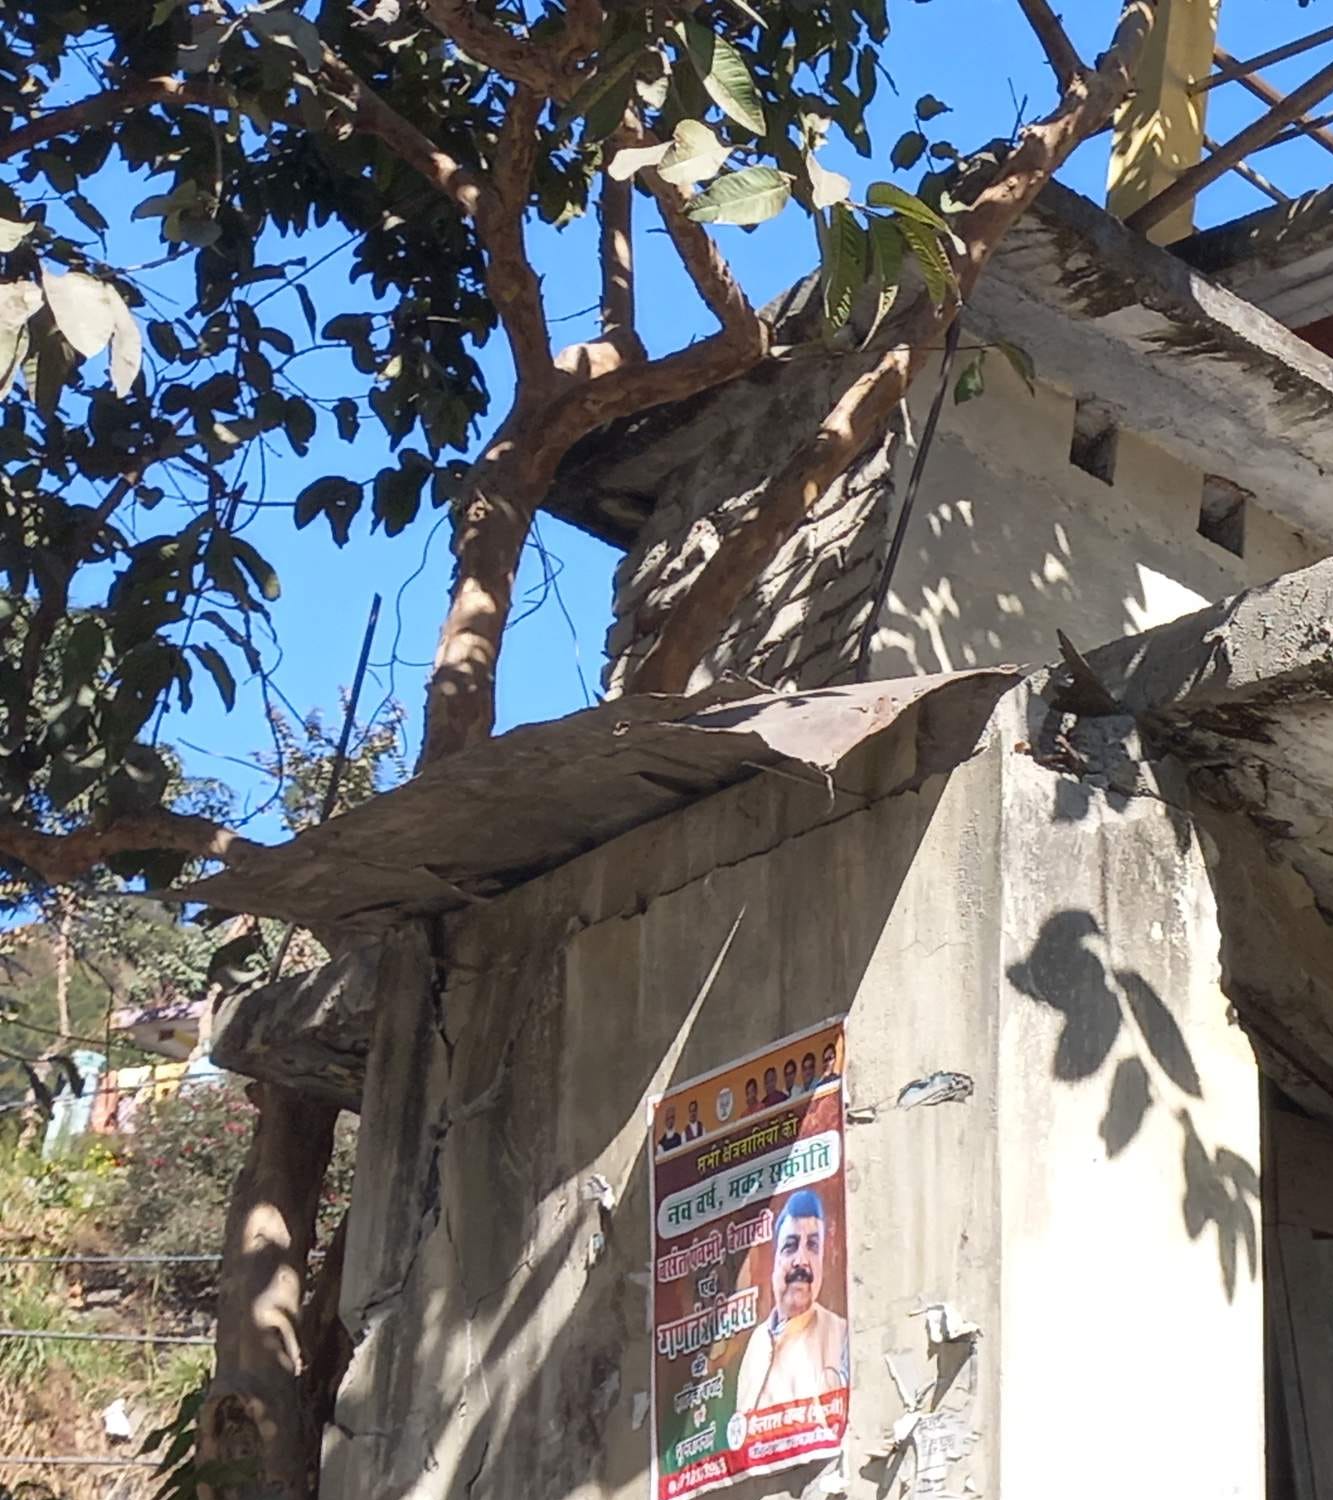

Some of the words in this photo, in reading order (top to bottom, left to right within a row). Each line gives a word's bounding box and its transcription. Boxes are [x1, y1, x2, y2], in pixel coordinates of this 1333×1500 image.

[696, 1144, 719, 1175] सभी
[783, 1113, 799, 1137] को
[668, 1199, 691, 1225] नव
[697, 1182, 723, 1213] वर्ष,
[729, 1168, 763, 1198] मकर
